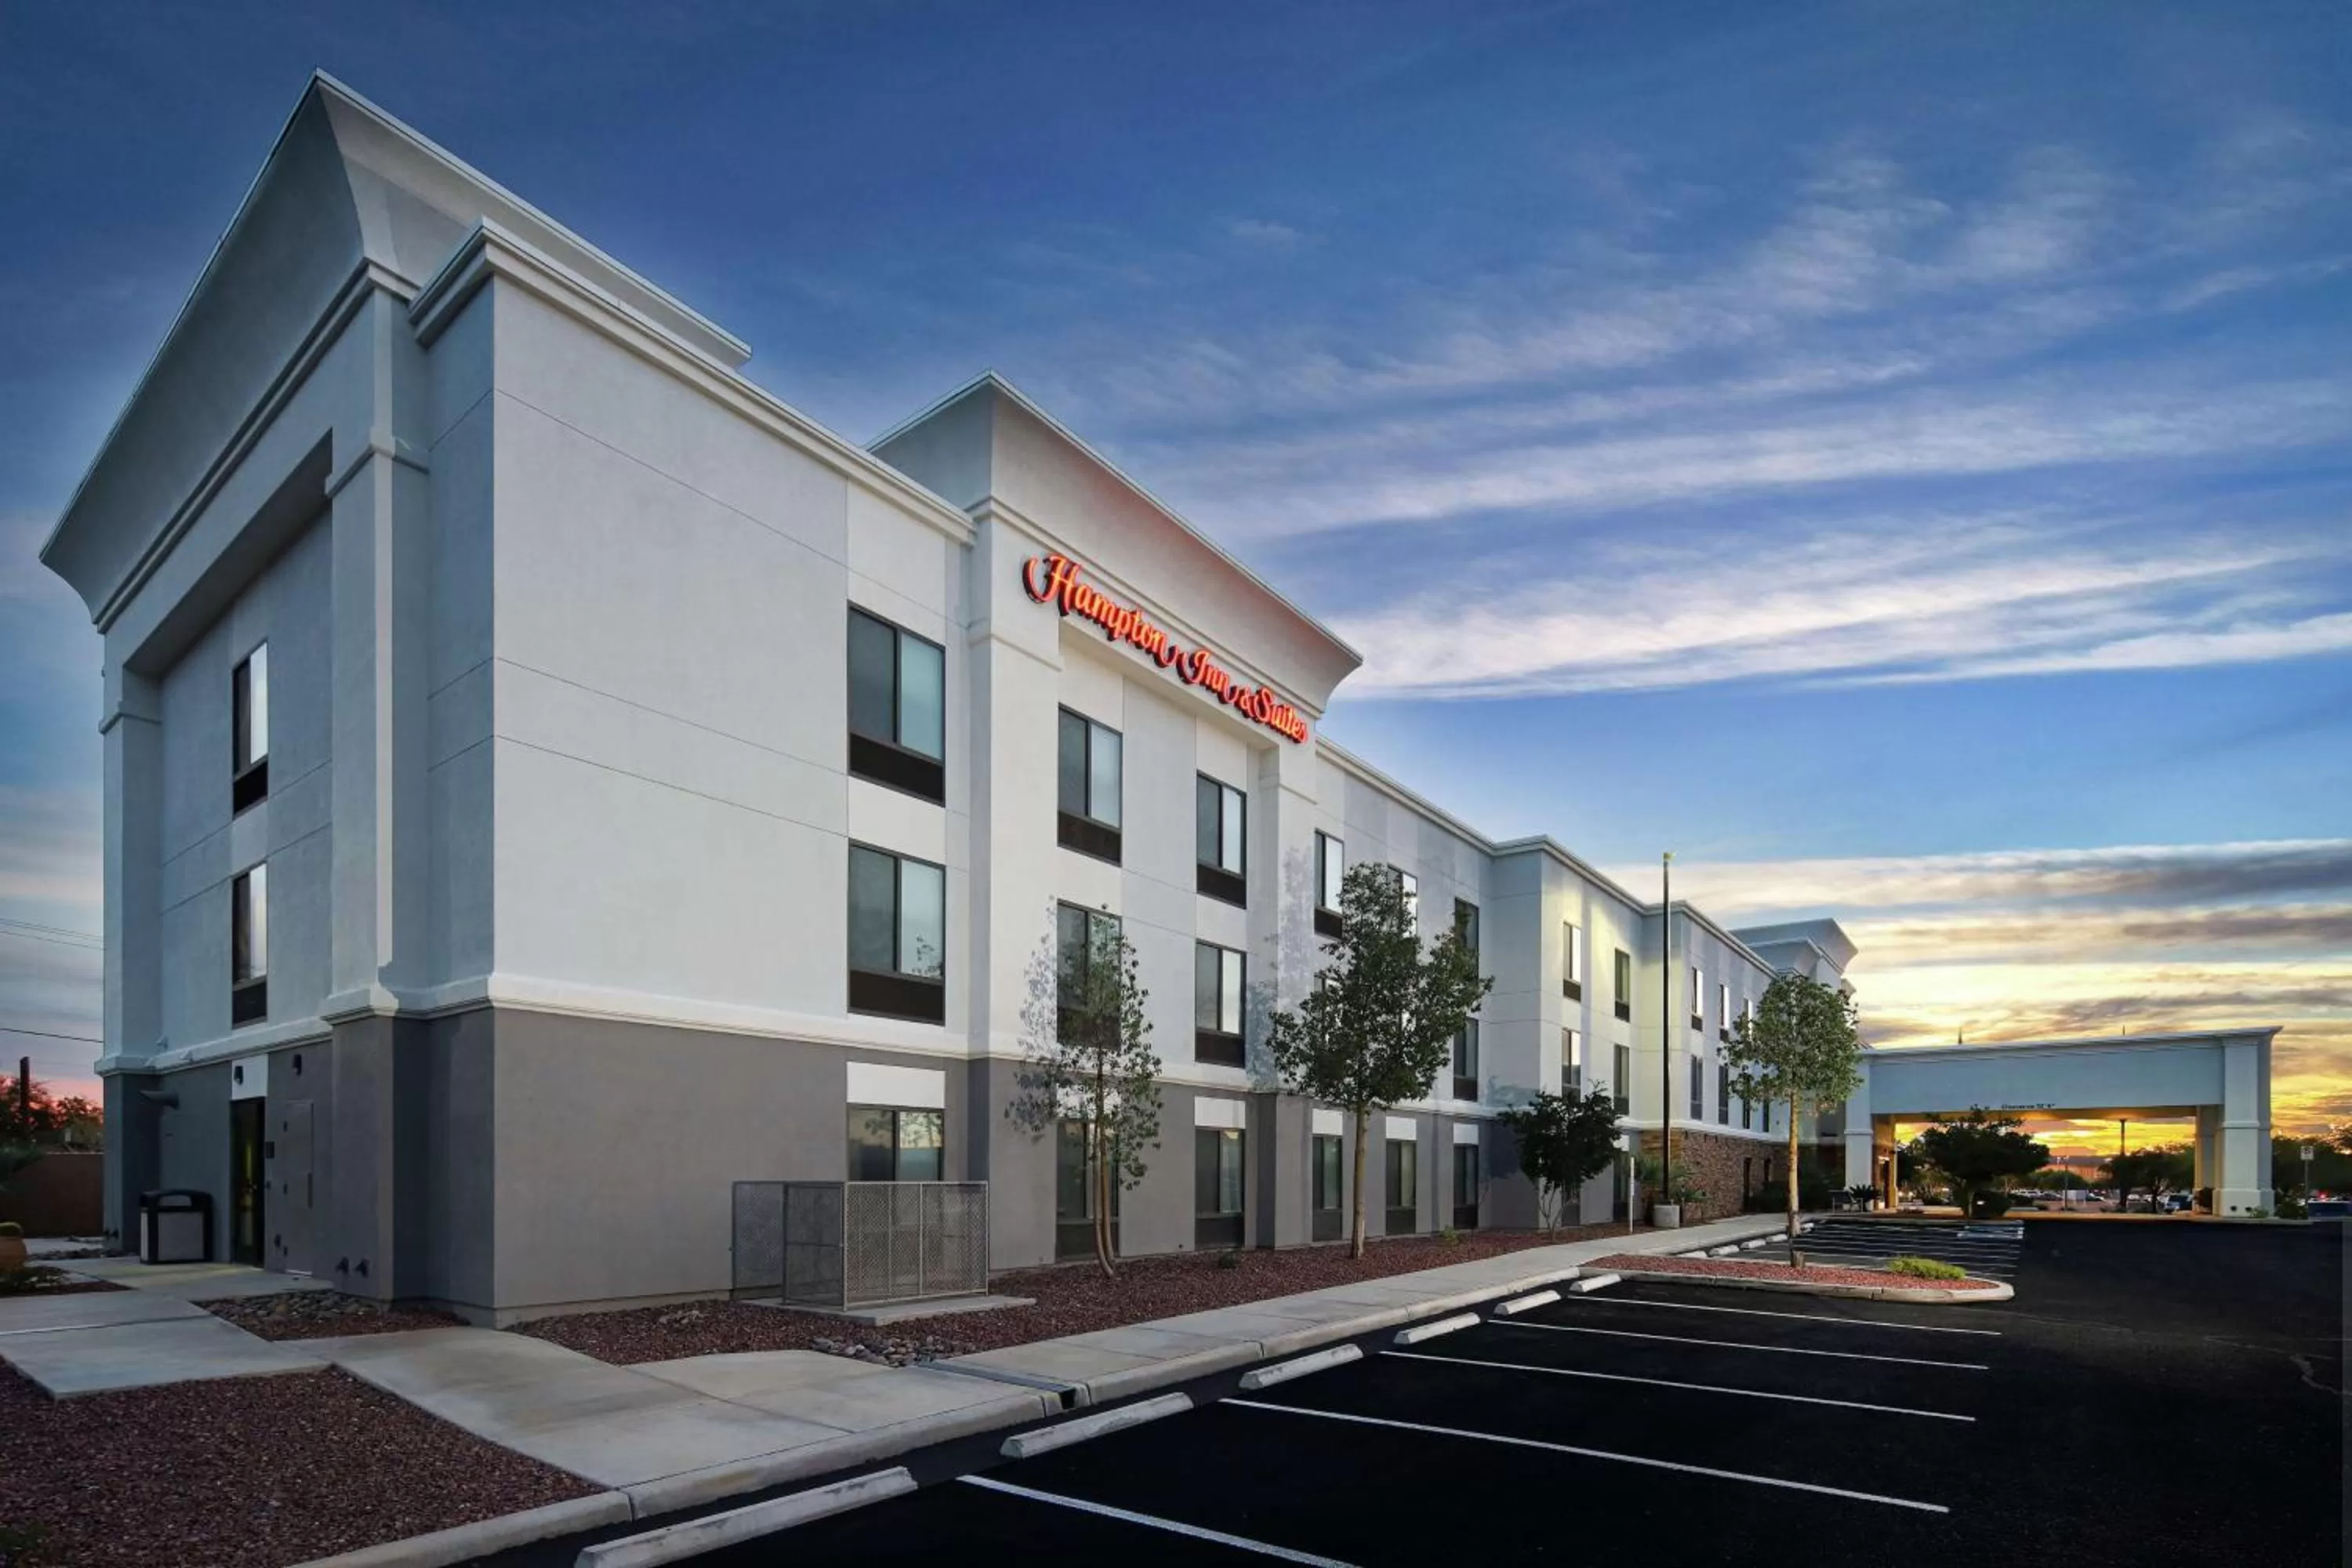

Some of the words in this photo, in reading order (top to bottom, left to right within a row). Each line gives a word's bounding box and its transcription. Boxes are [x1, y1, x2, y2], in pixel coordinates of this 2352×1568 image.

[1022, 554, 1179, 668] Hampton
[1177, 650, 1239, 704] Inn
[1236, 684, 1256, 718] &
[1254, 686, 1308, 743] Suites
